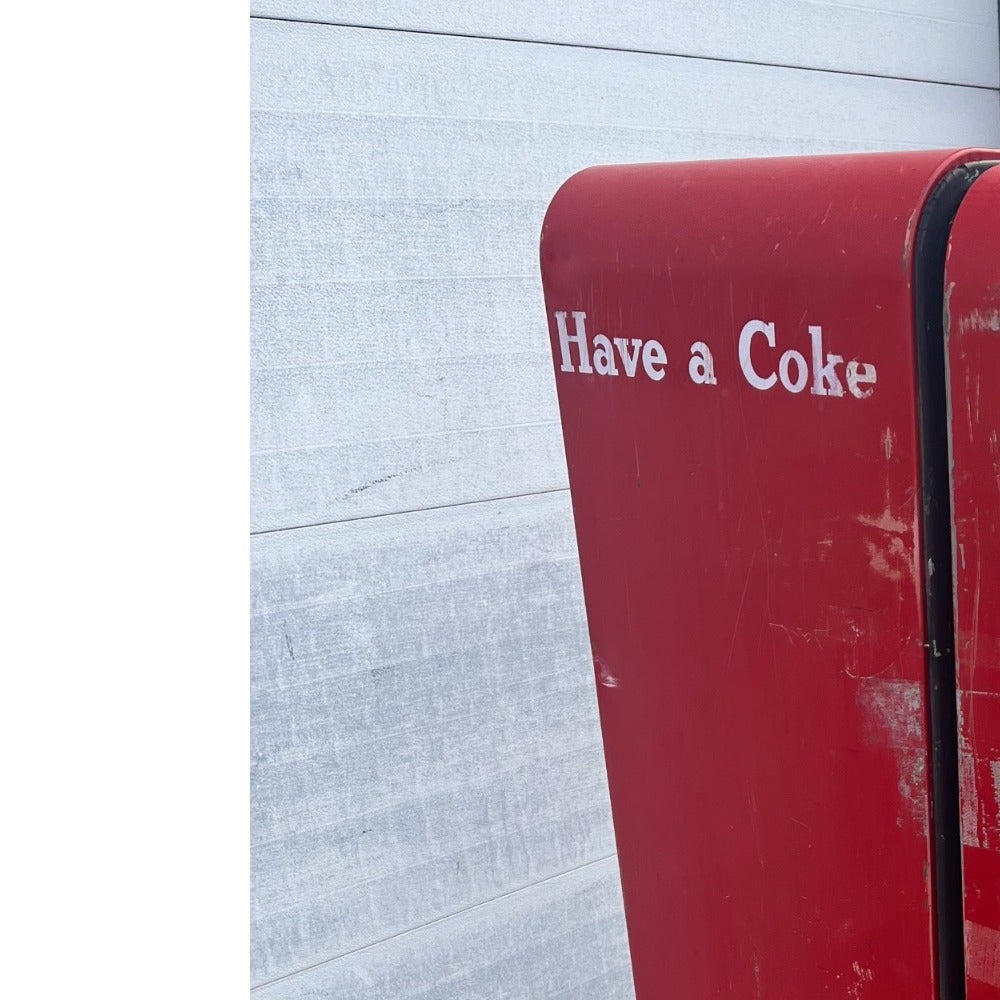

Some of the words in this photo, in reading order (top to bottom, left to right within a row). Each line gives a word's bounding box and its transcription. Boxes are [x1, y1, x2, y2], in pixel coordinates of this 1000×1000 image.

[554, 311, 668, 381] Have
[688, 340, 717, 385] a
[738, 319, 877, 399] Coke
